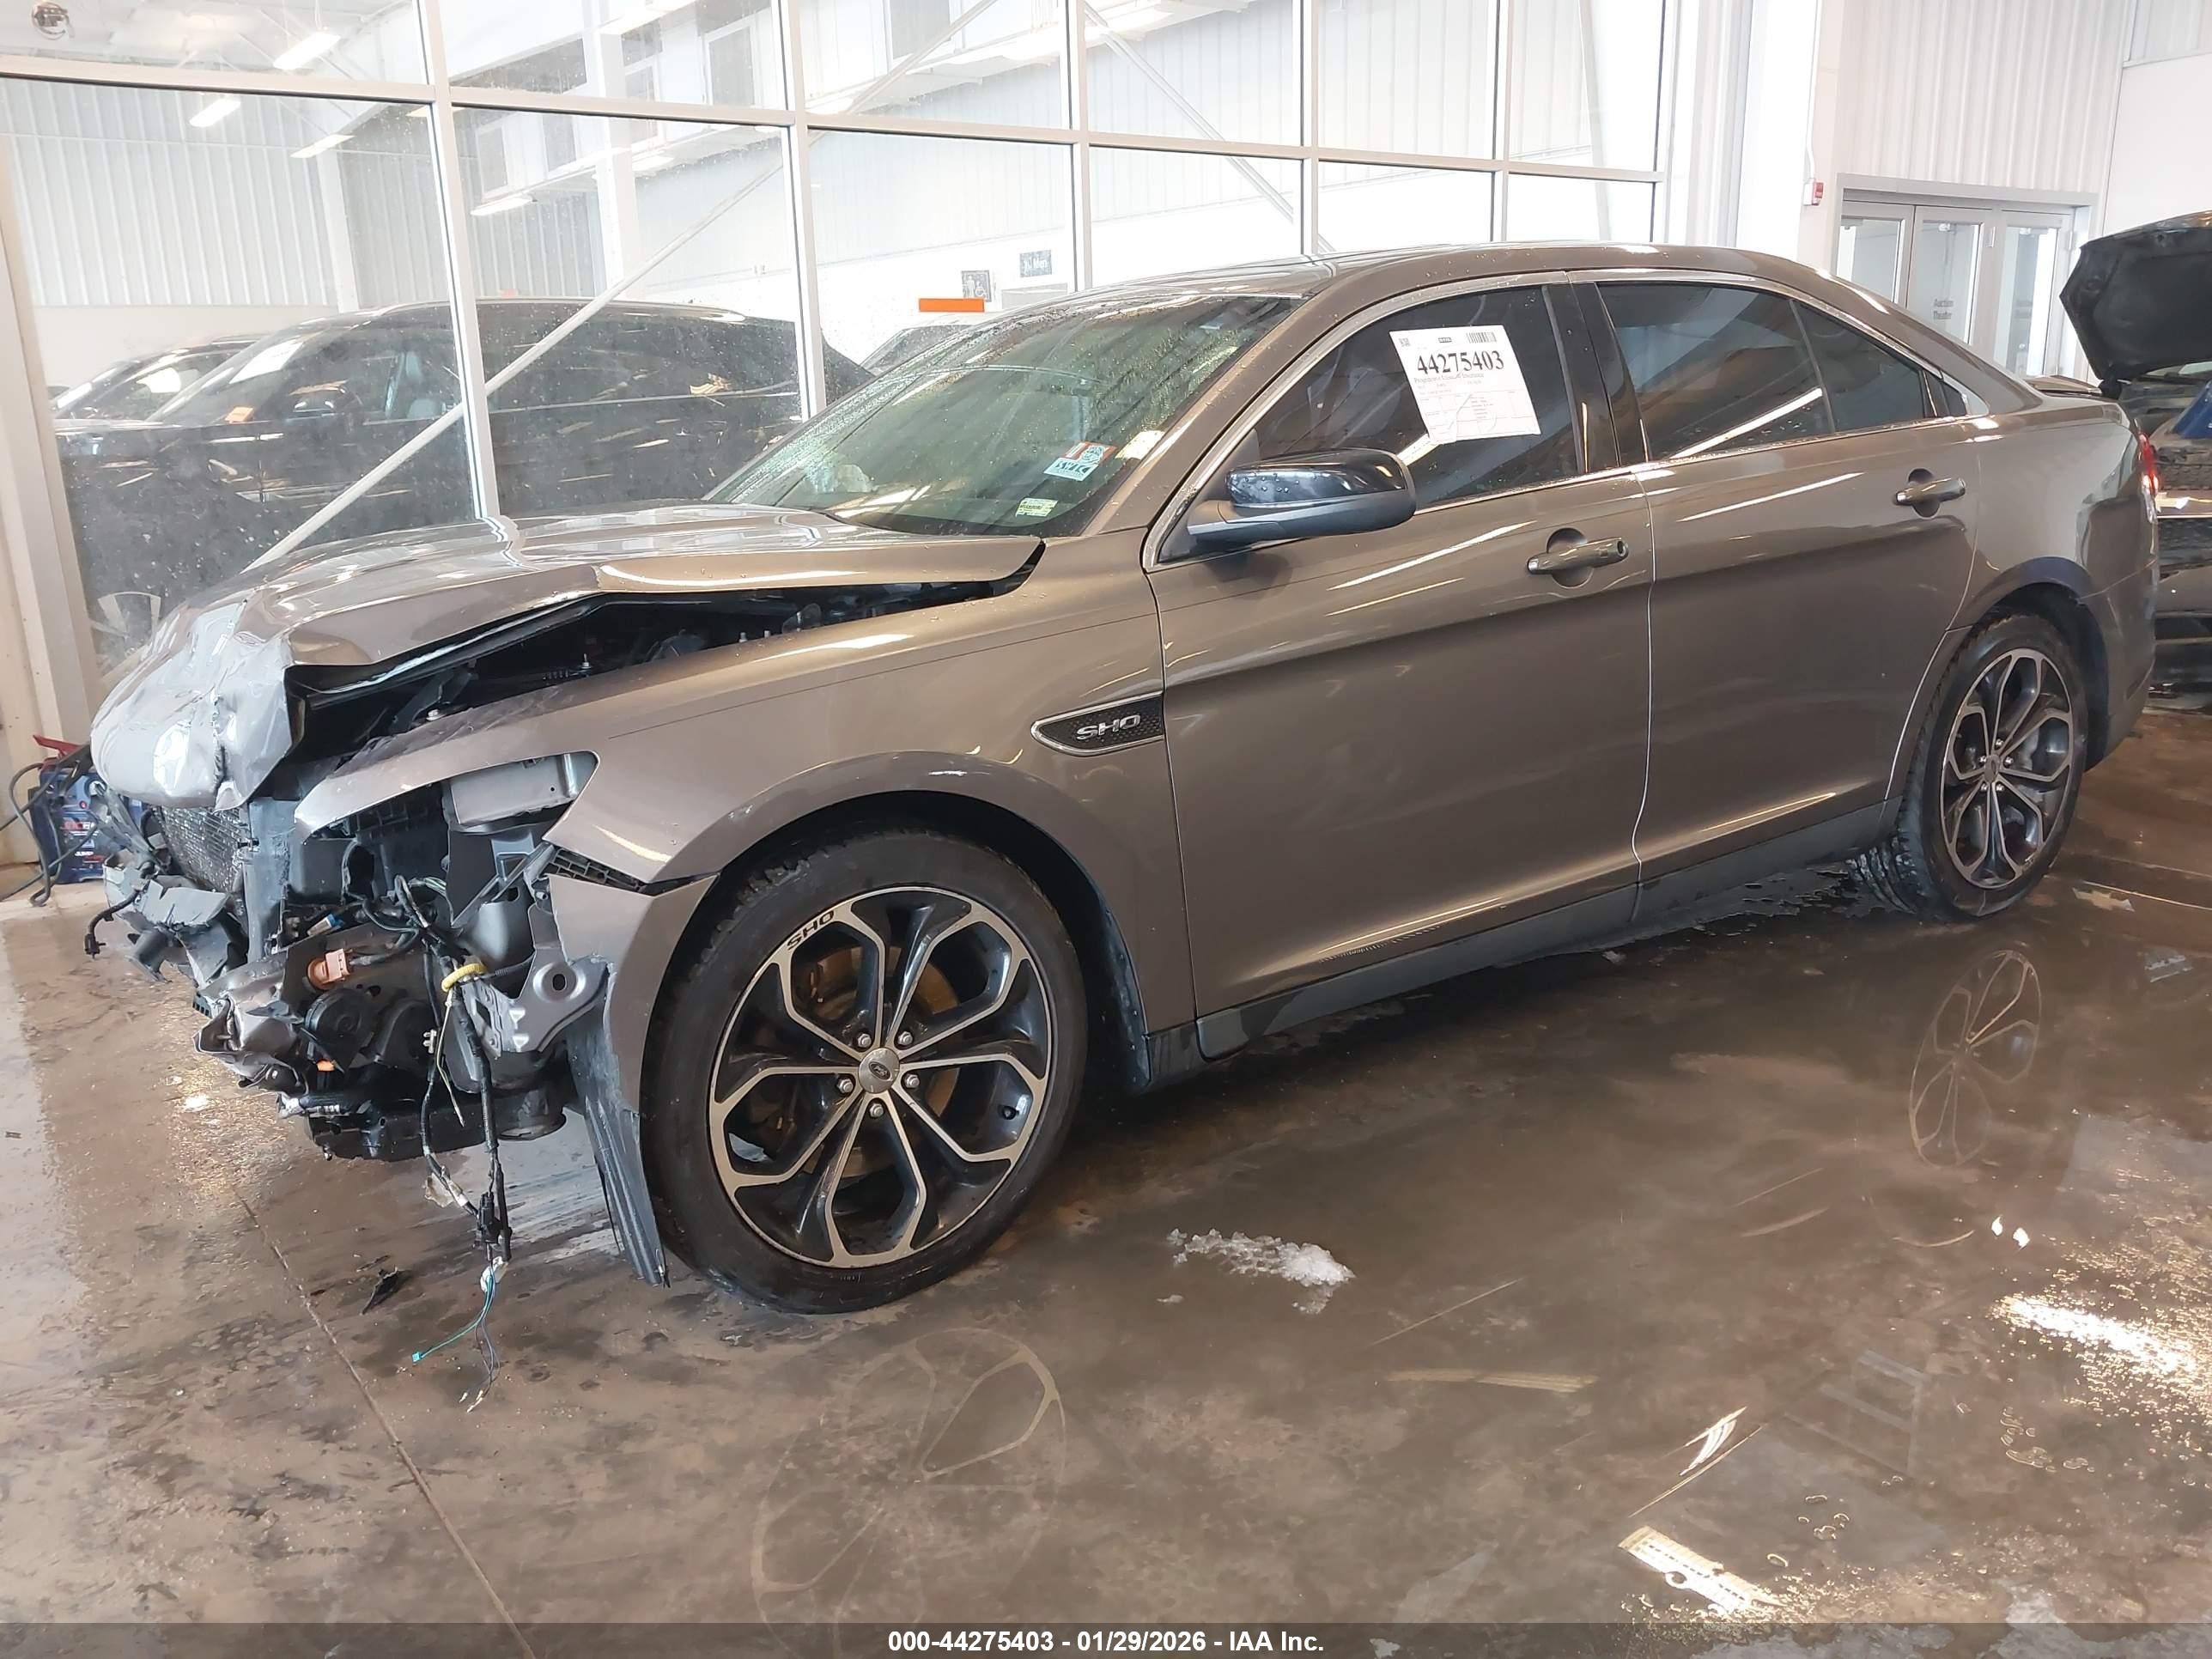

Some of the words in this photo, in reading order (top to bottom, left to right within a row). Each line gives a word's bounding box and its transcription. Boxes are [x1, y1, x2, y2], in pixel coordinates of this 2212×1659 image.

[1417, 350, 1504, 374] 44275403
[1076, 714, 1140, 740] SHO
[787, 910, 835, 951] SHO
